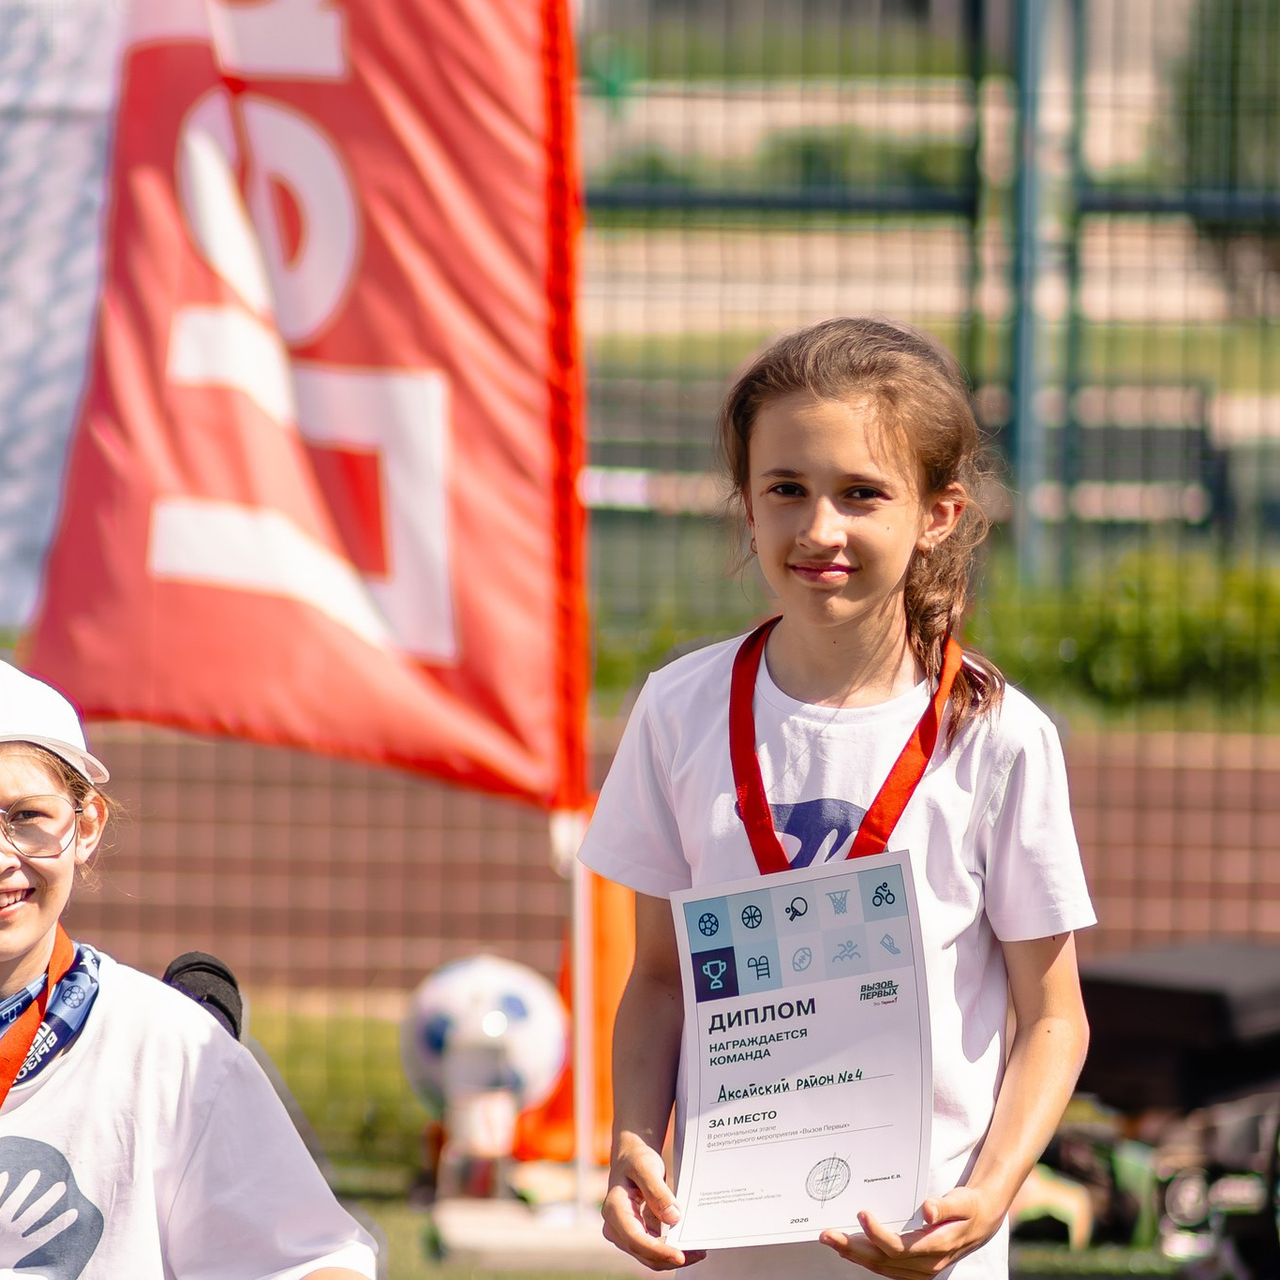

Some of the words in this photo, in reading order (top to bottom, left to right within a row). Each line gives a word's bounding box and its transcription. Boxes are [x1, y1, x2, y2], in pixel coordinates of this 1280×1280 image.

[859, 987, 898, 1002] ПЕРВЫХ
[708, 997, 816, 1035] ДИПЛОМ
[709, 1028, 808, 1053] НАГРАЖДАЕТСЯ
[13, 1029, 59, 1085] ВЫЗО
[709, 1048, 771, 1067] КОМАНДА
[708, 1118, 725, 1129] ЗА
[733, 1110, 777, 1125] МЕСТО
